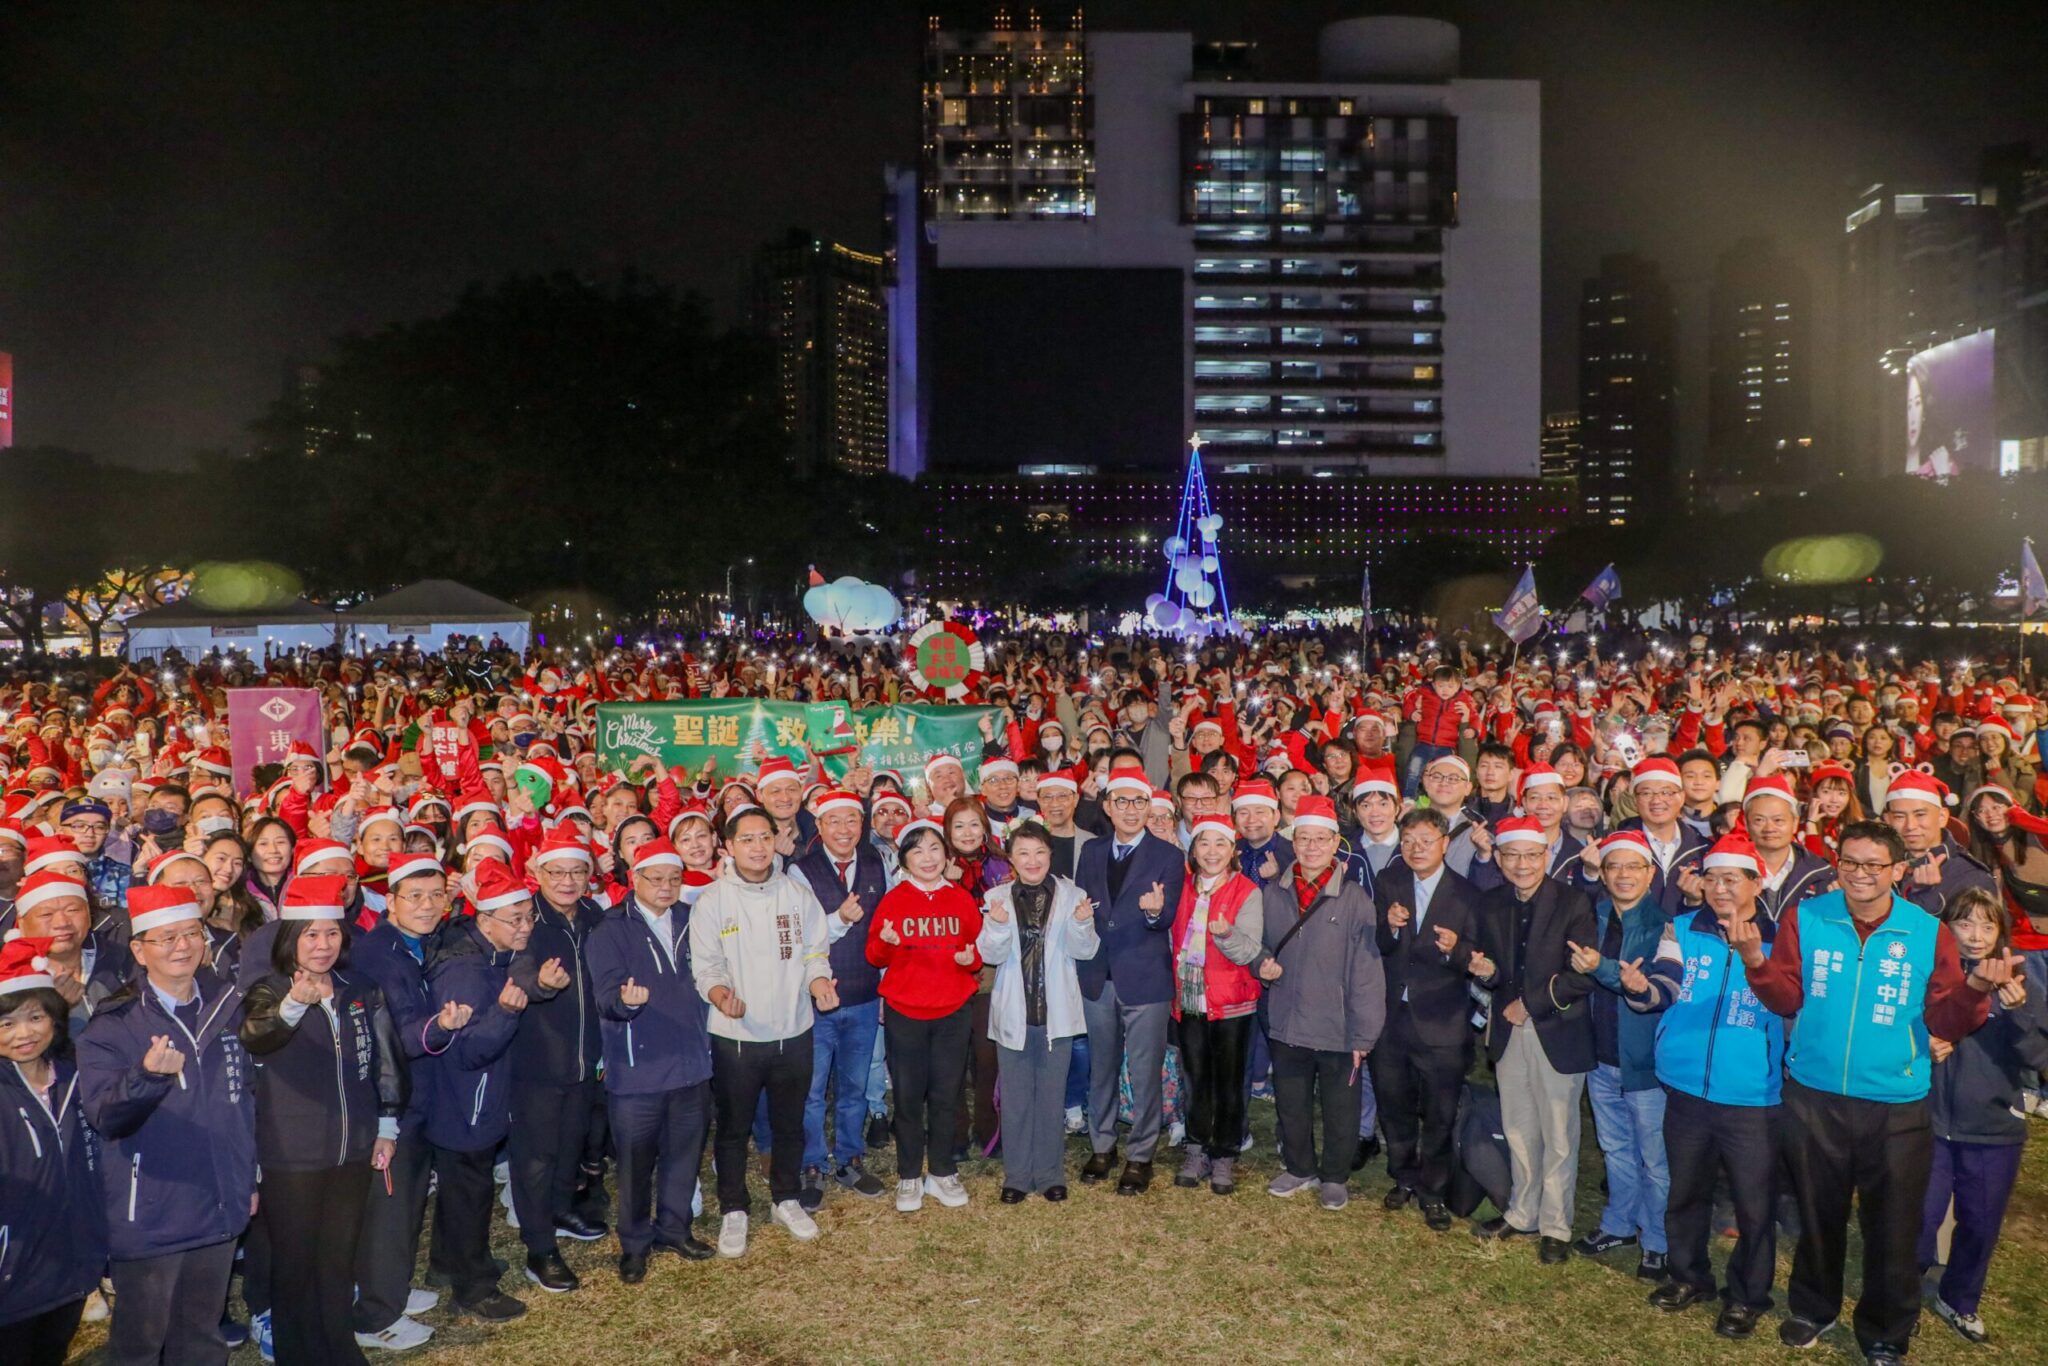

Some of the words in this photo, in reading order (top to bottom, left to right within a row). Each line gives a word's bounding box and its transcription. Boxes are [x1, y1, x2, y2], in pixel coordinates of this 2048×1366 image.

[606, 720, 663, 757] Christmas
[622, 713, 660, 738] Merry
[673, 714, 738, 746] 聖誕
[902, 916, 960, 937] CKHU
